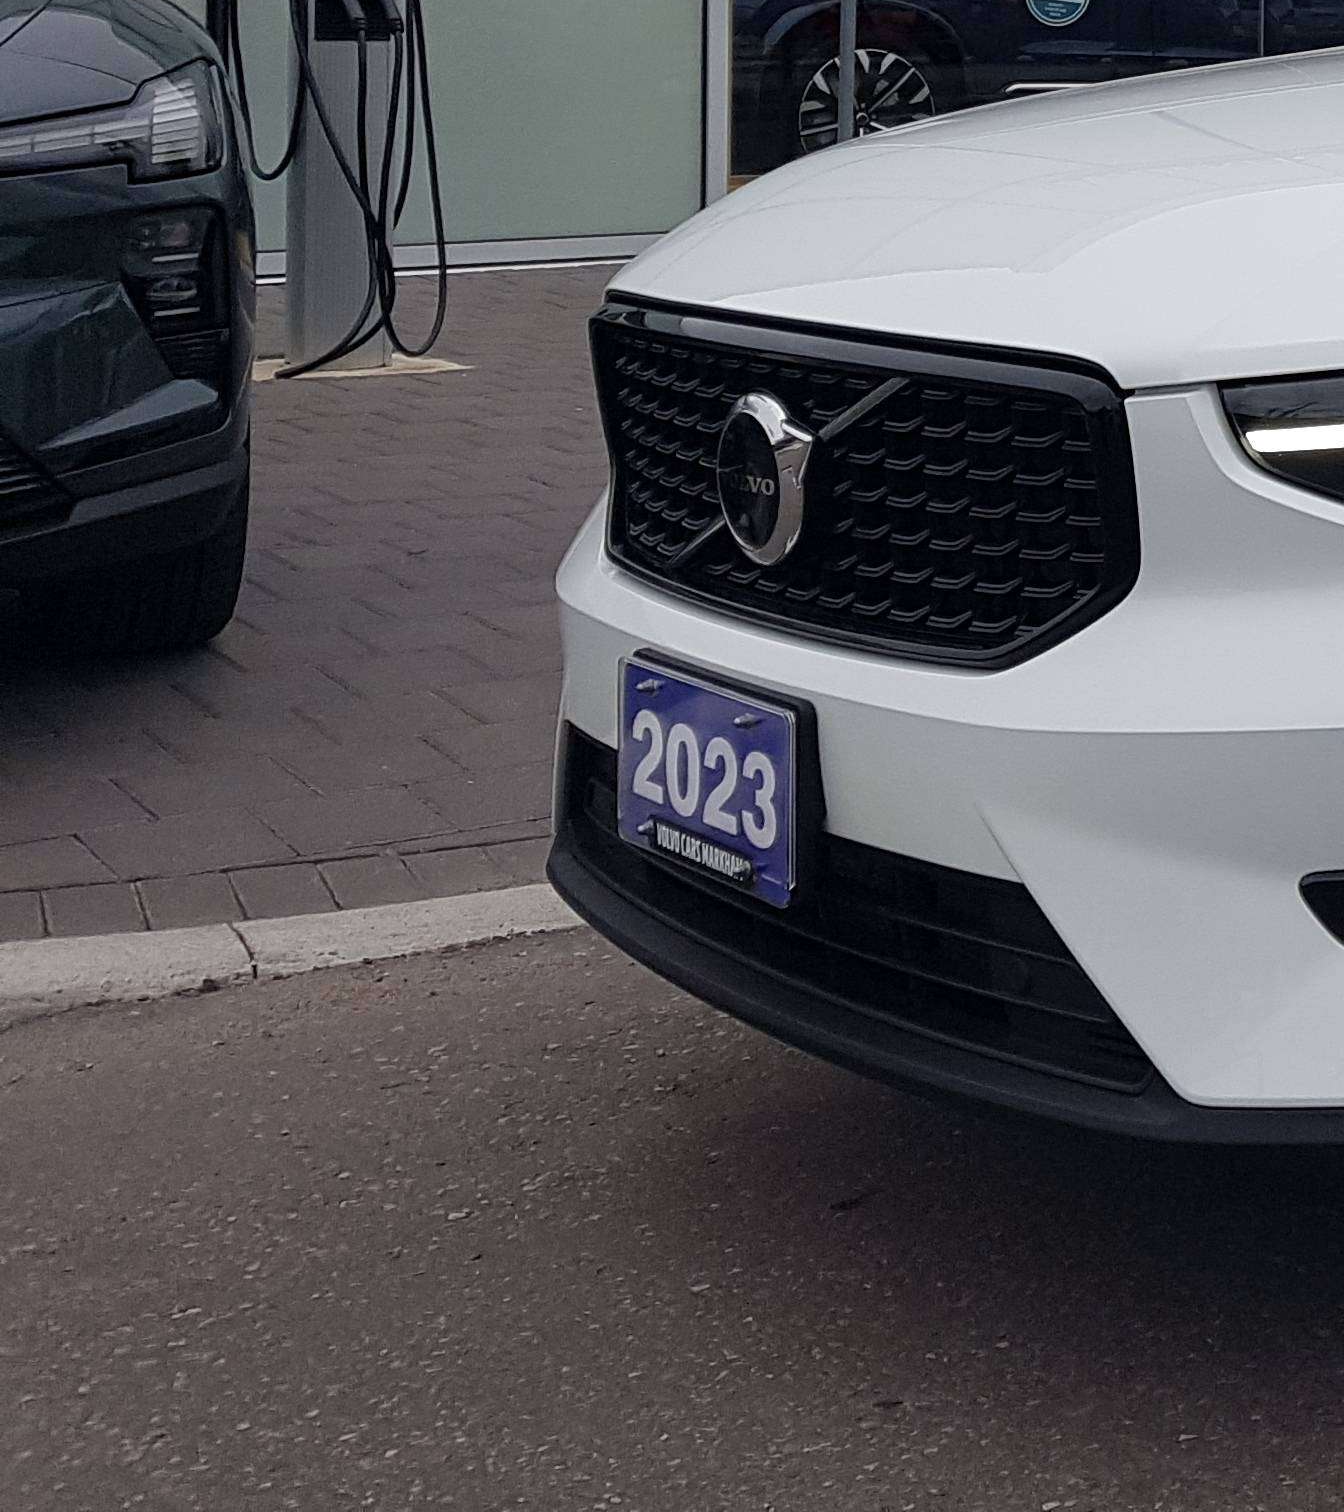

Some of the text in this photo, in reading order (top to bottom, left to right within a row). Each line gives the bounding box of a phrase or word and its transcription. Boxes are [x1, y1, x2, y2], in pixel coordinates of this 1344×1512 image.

[632, 708, 777, 850] 2023
[656, 822, 681, 854] VOLVO
[680, 832, 702, 863] CARS
